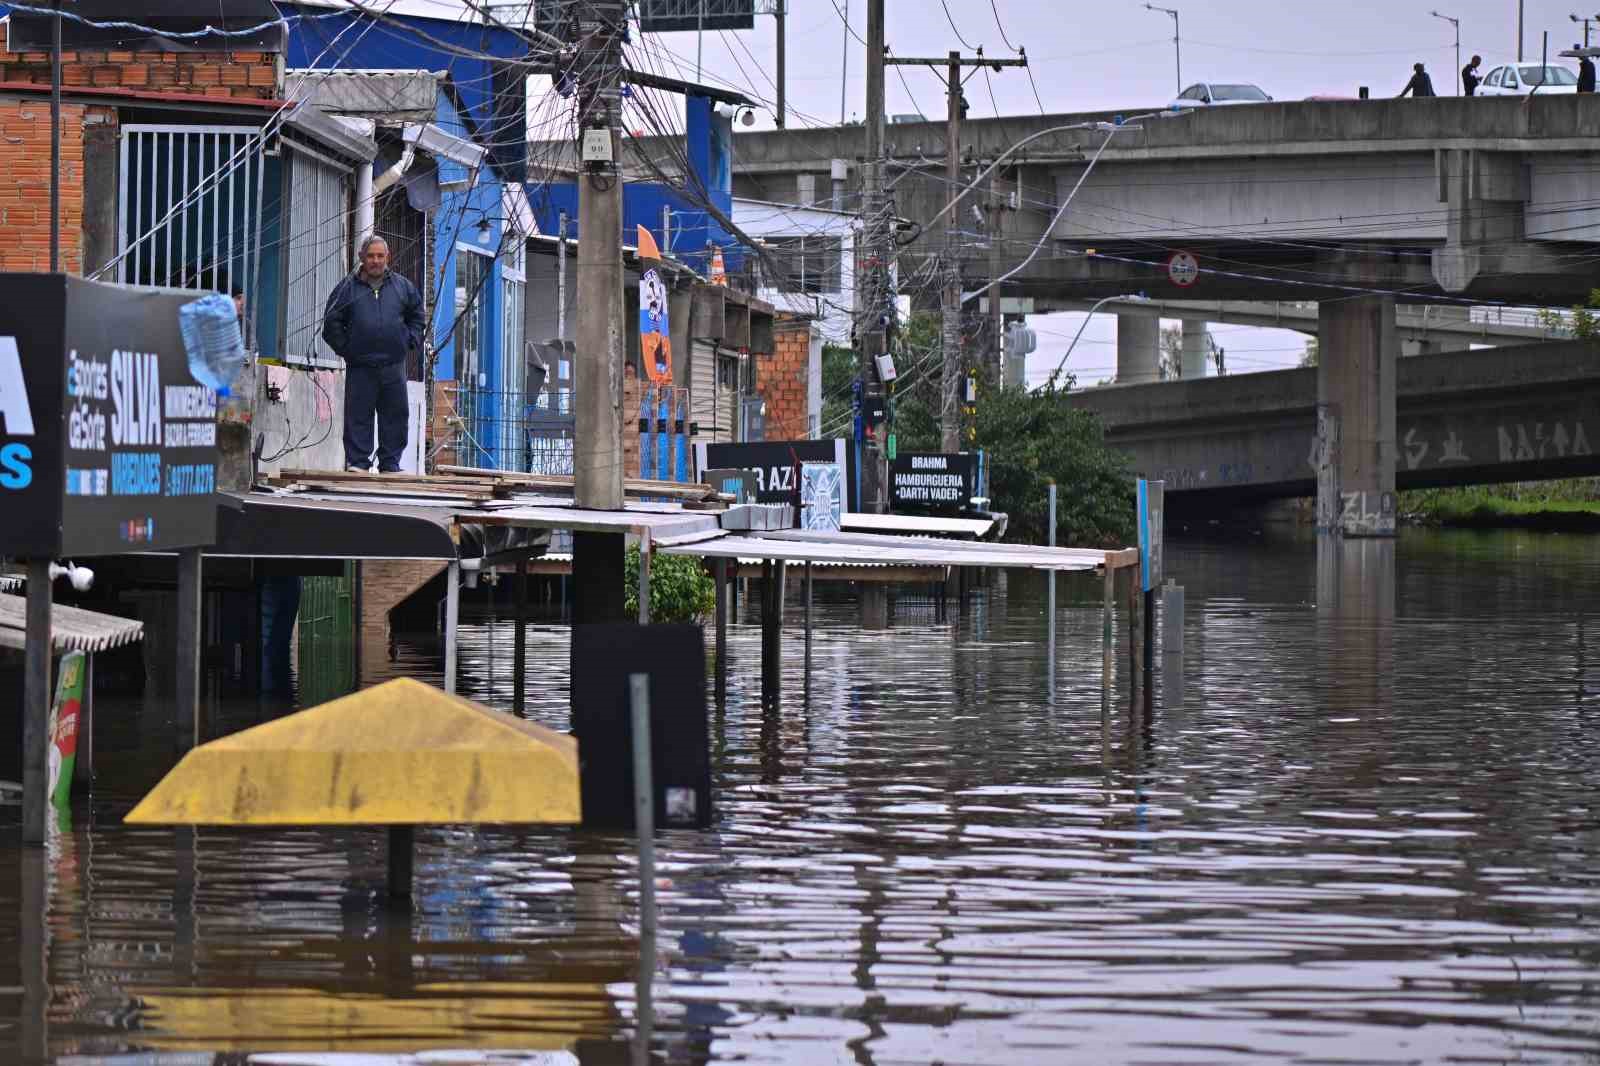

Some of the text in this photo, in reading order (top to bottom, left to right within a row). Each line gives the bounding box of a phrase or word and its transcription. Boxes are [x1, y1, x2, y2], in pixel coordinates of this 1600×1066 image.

[110, 349, 162, 446] SILVA
[912, 456, 947, 469] BRAHMA
[895, 473, 963, 488] HAMBURGUERIA
